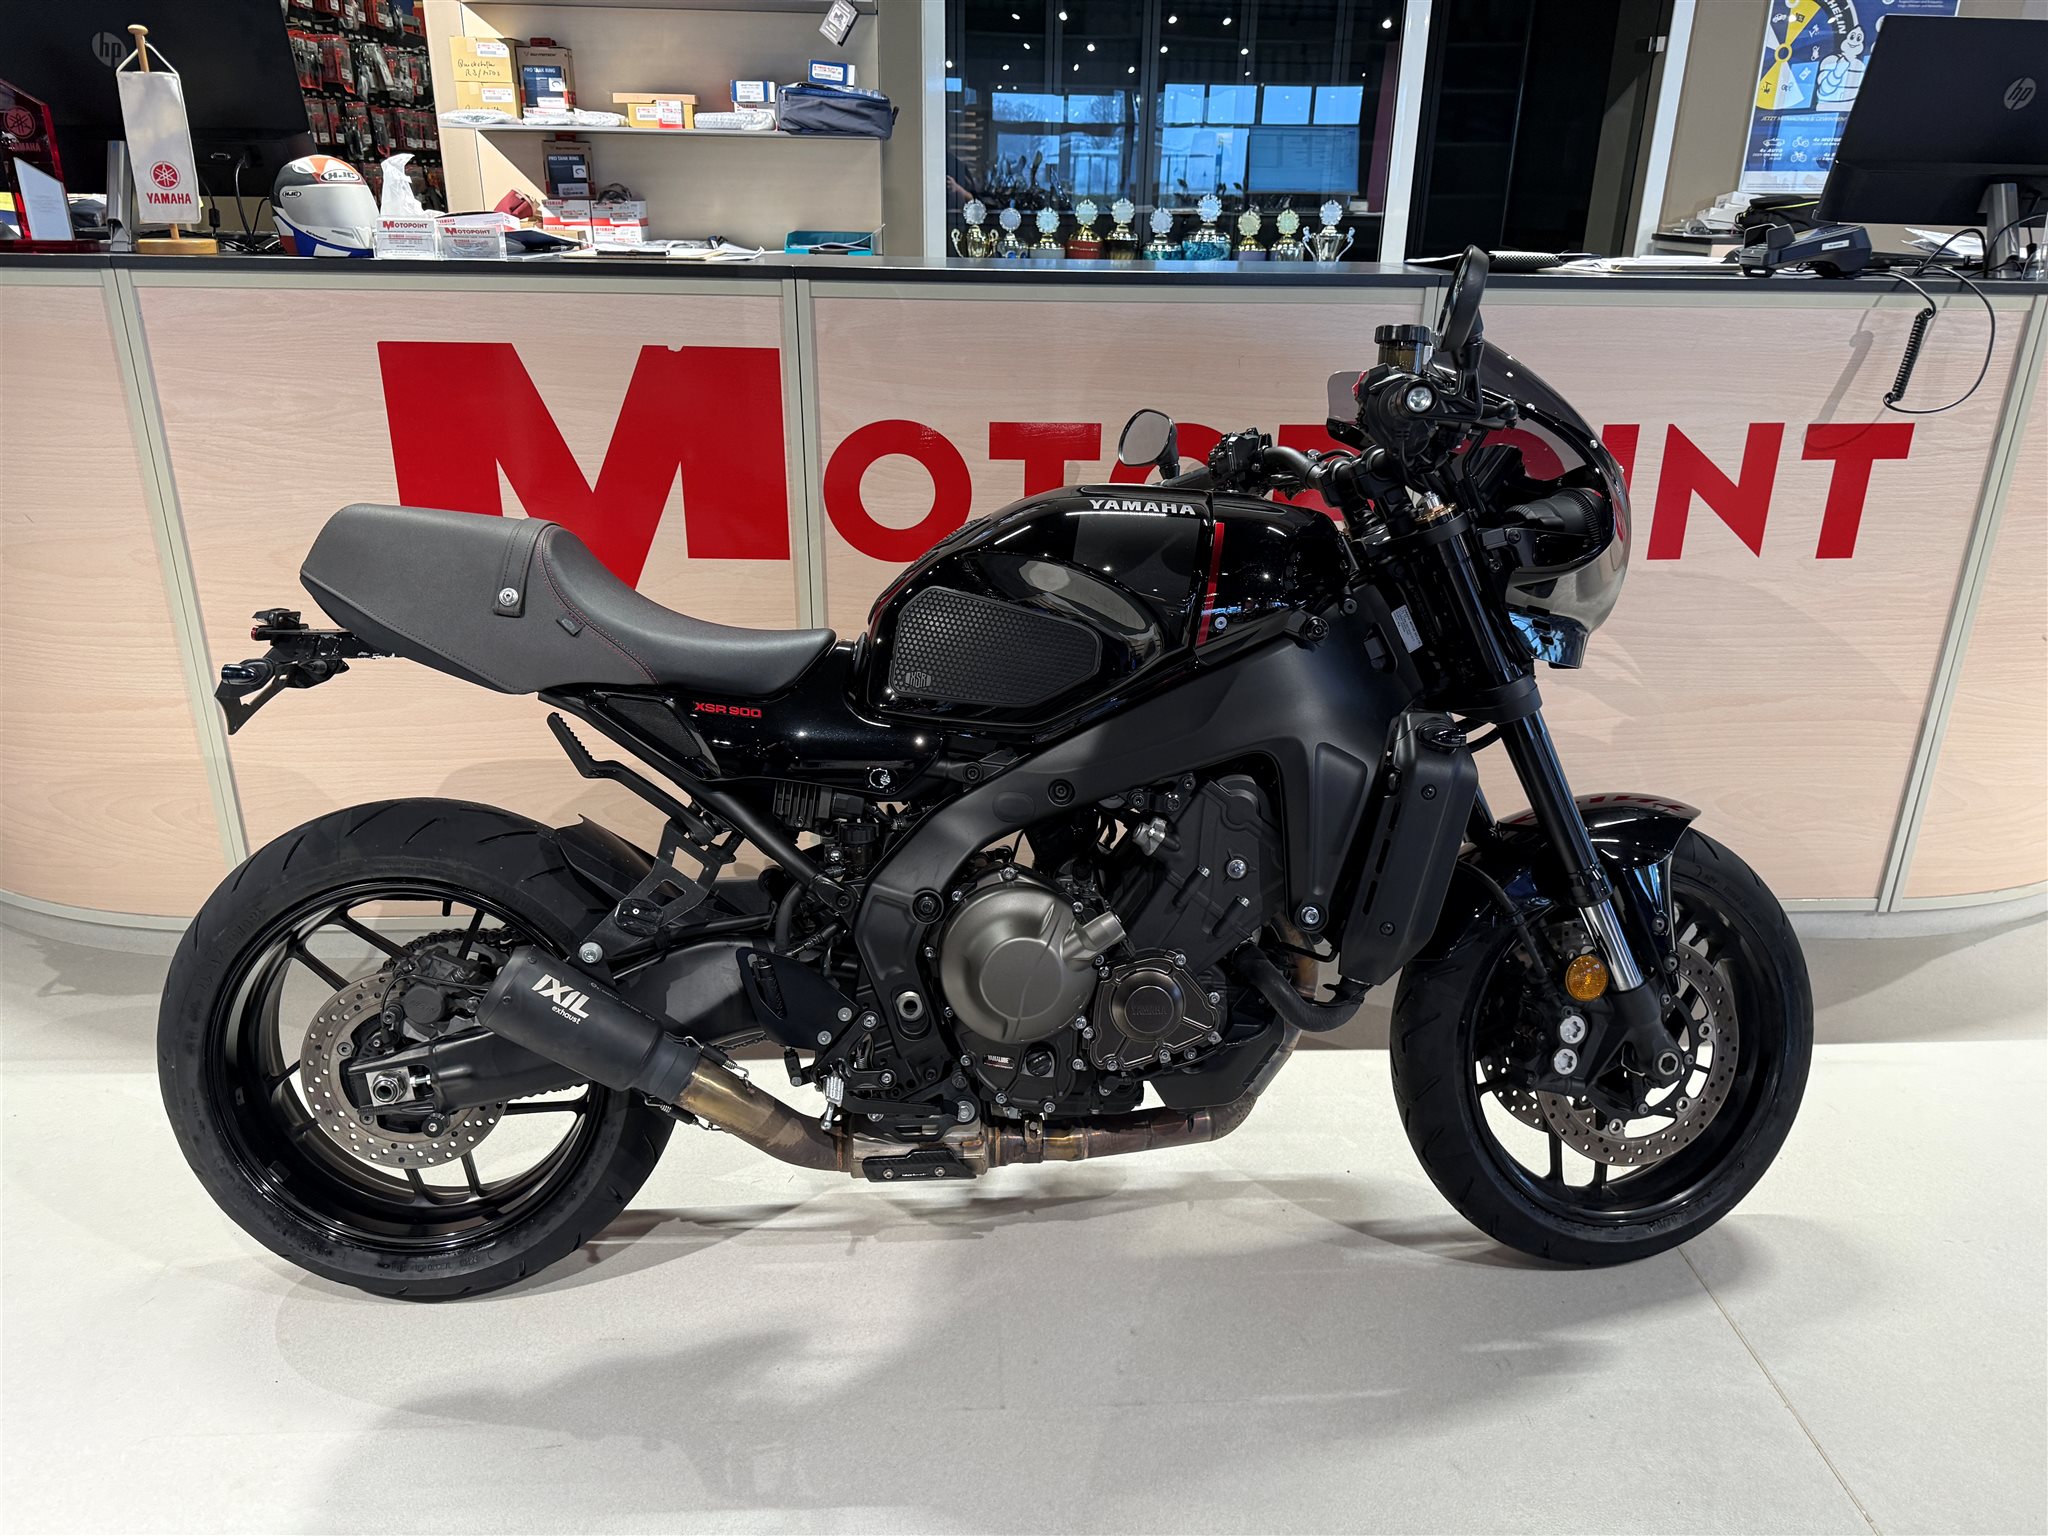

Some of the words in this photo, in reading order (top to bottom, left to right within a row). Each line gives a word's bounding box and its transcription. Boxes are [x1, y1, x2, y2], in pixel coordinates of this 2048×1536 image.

[1824, 0, 1847, 34] HELIN
[98, 31, 123, 69] hp
[2006, 78, 2034, 110] hp
[146, 192, 192, 205] YAMAHA
[382, 220, 428, 230] MOTOPOINT
[444, 227, 491, 235] MOTOPOINT
[1089, 499, 1196, 515] YAMAHA
[694, 702, 727, 713] XSR
[728, 706, 762, 718] 900
[531, 973, 590, 1019] IXIL
[551, 1005, 581, 1025] exhaust
